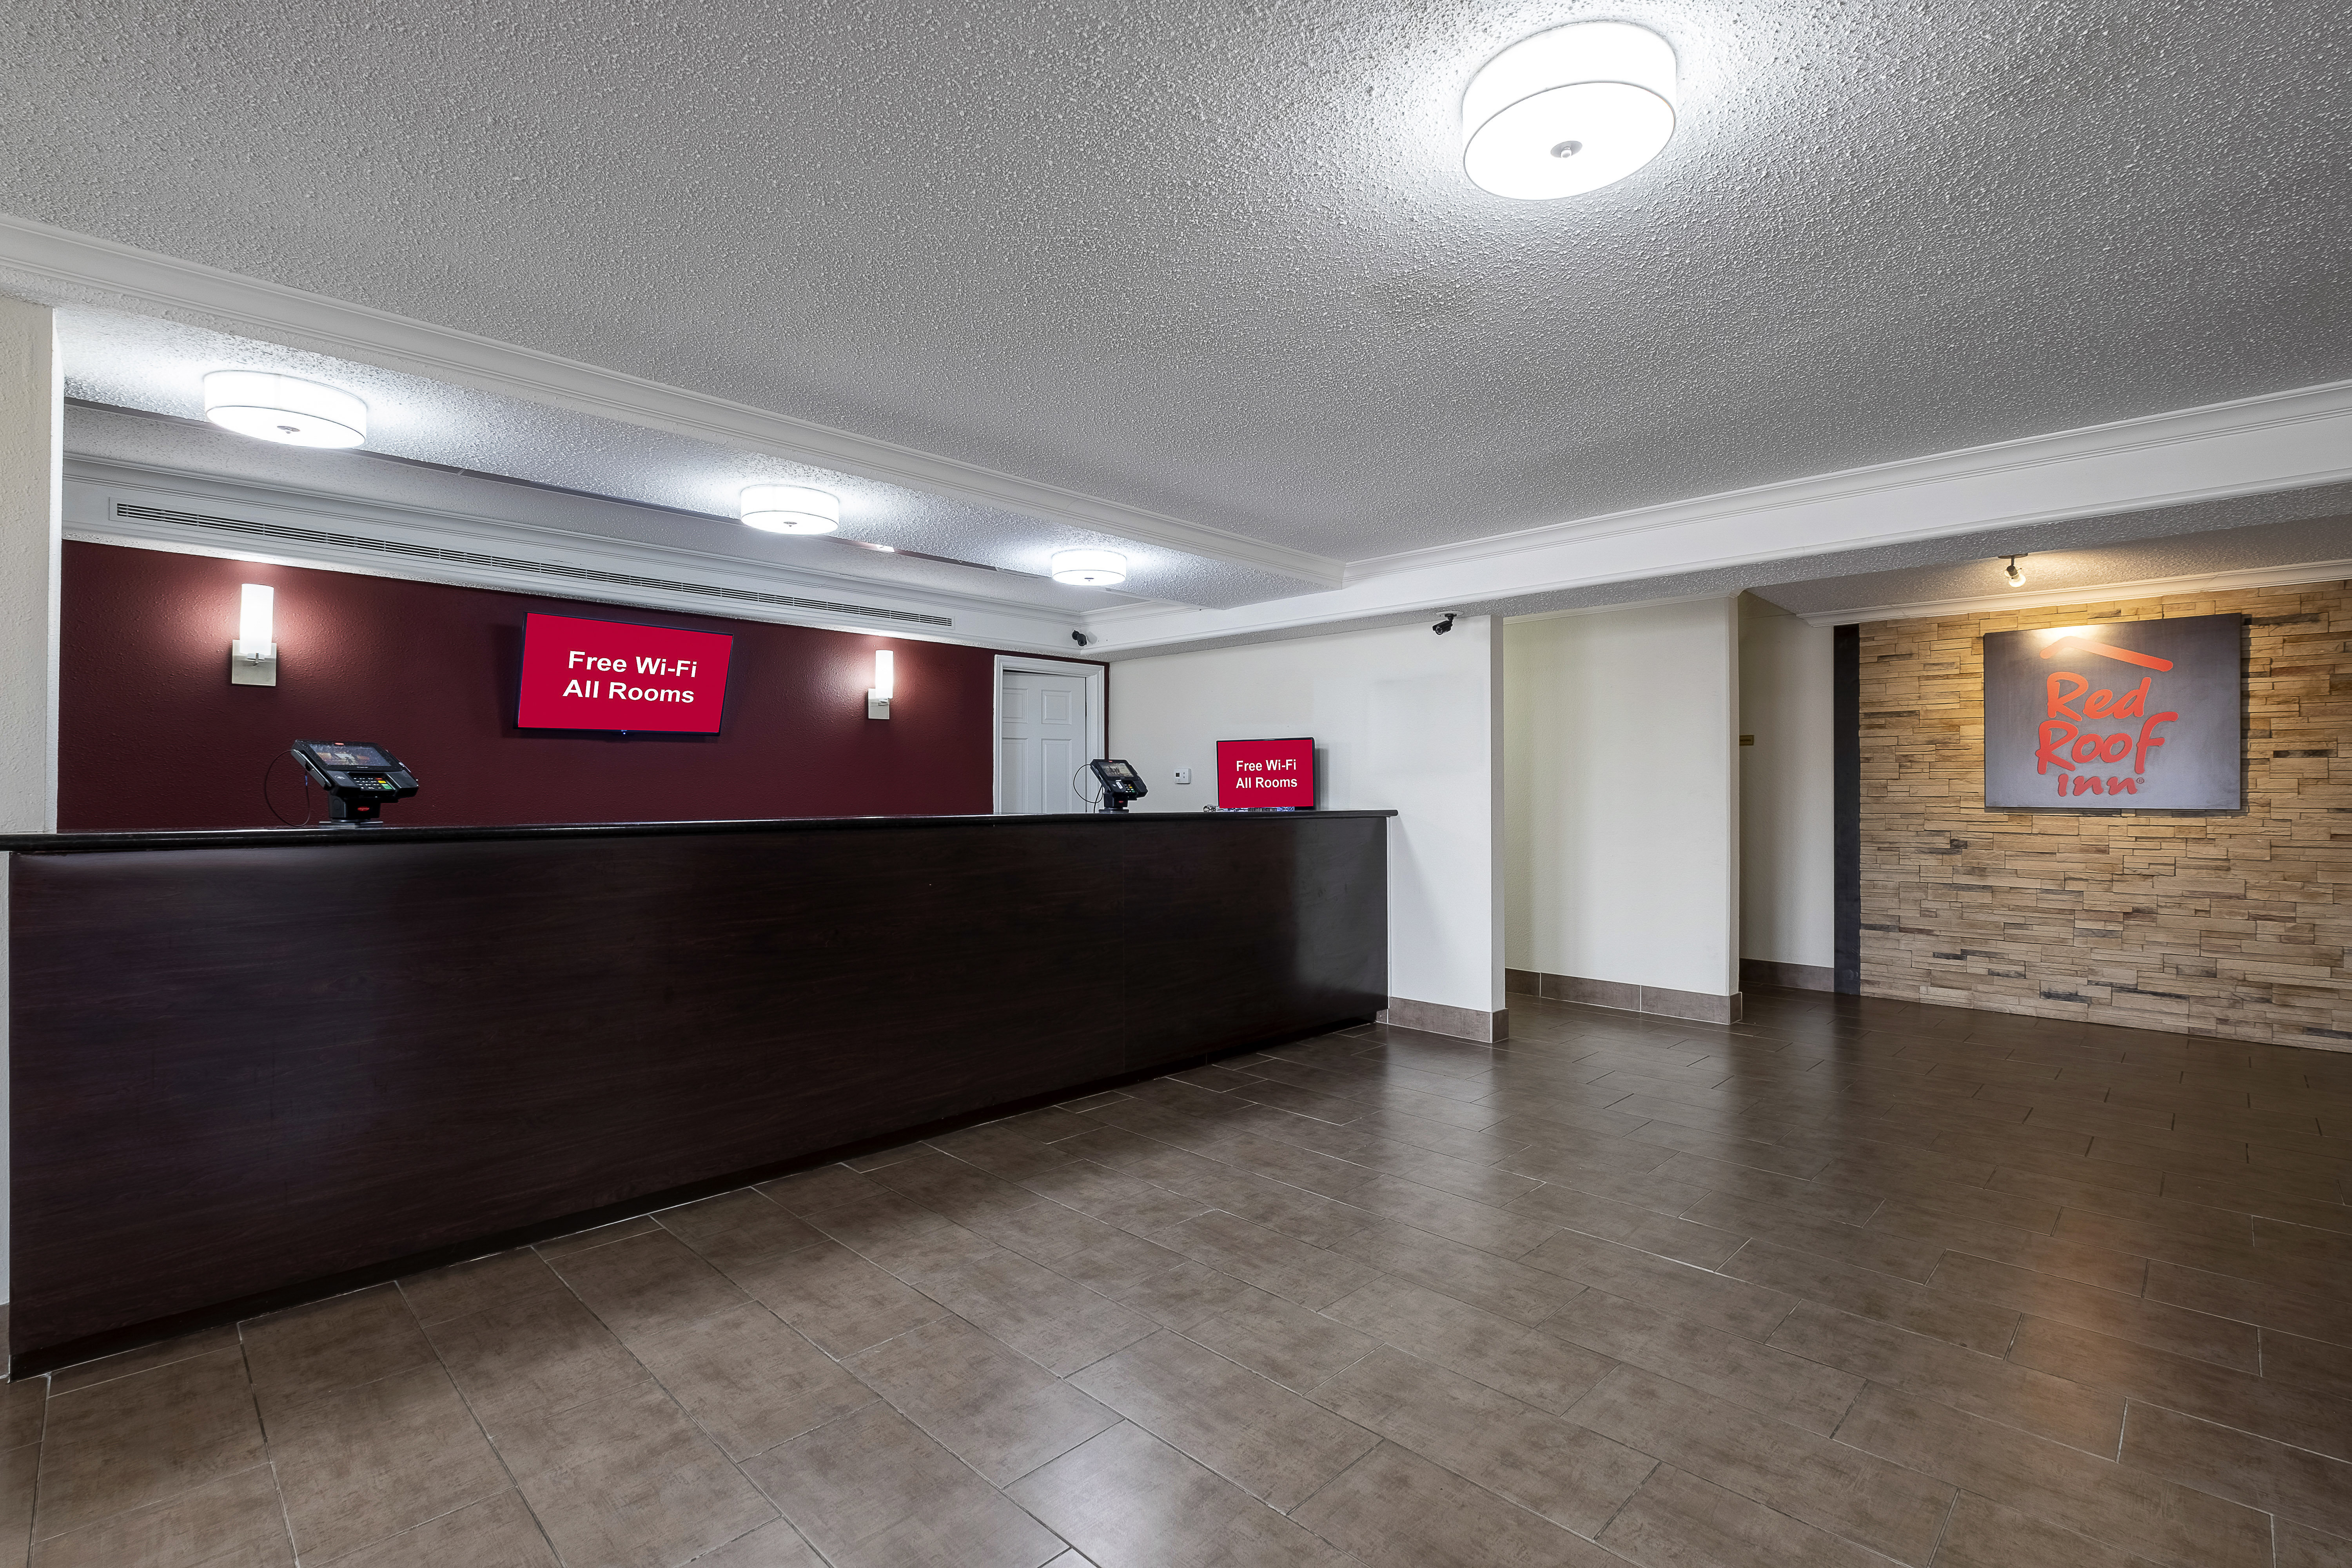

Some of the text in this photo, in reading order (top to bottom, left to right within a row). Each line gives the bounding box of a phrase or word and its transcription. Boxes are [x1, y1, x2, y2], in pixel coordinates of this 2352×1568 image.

[568, 650, 697, 678] Free Wi-Fi
[562, 679, 694, 703] All Rooms
[2046, 671, 2152, 722] Red
[2035, 711, 2179, 775] Roof
[1236, 759, 1296, 771] Free Wi-Fi
[1236, 777, 1298, 789] All Rooms
